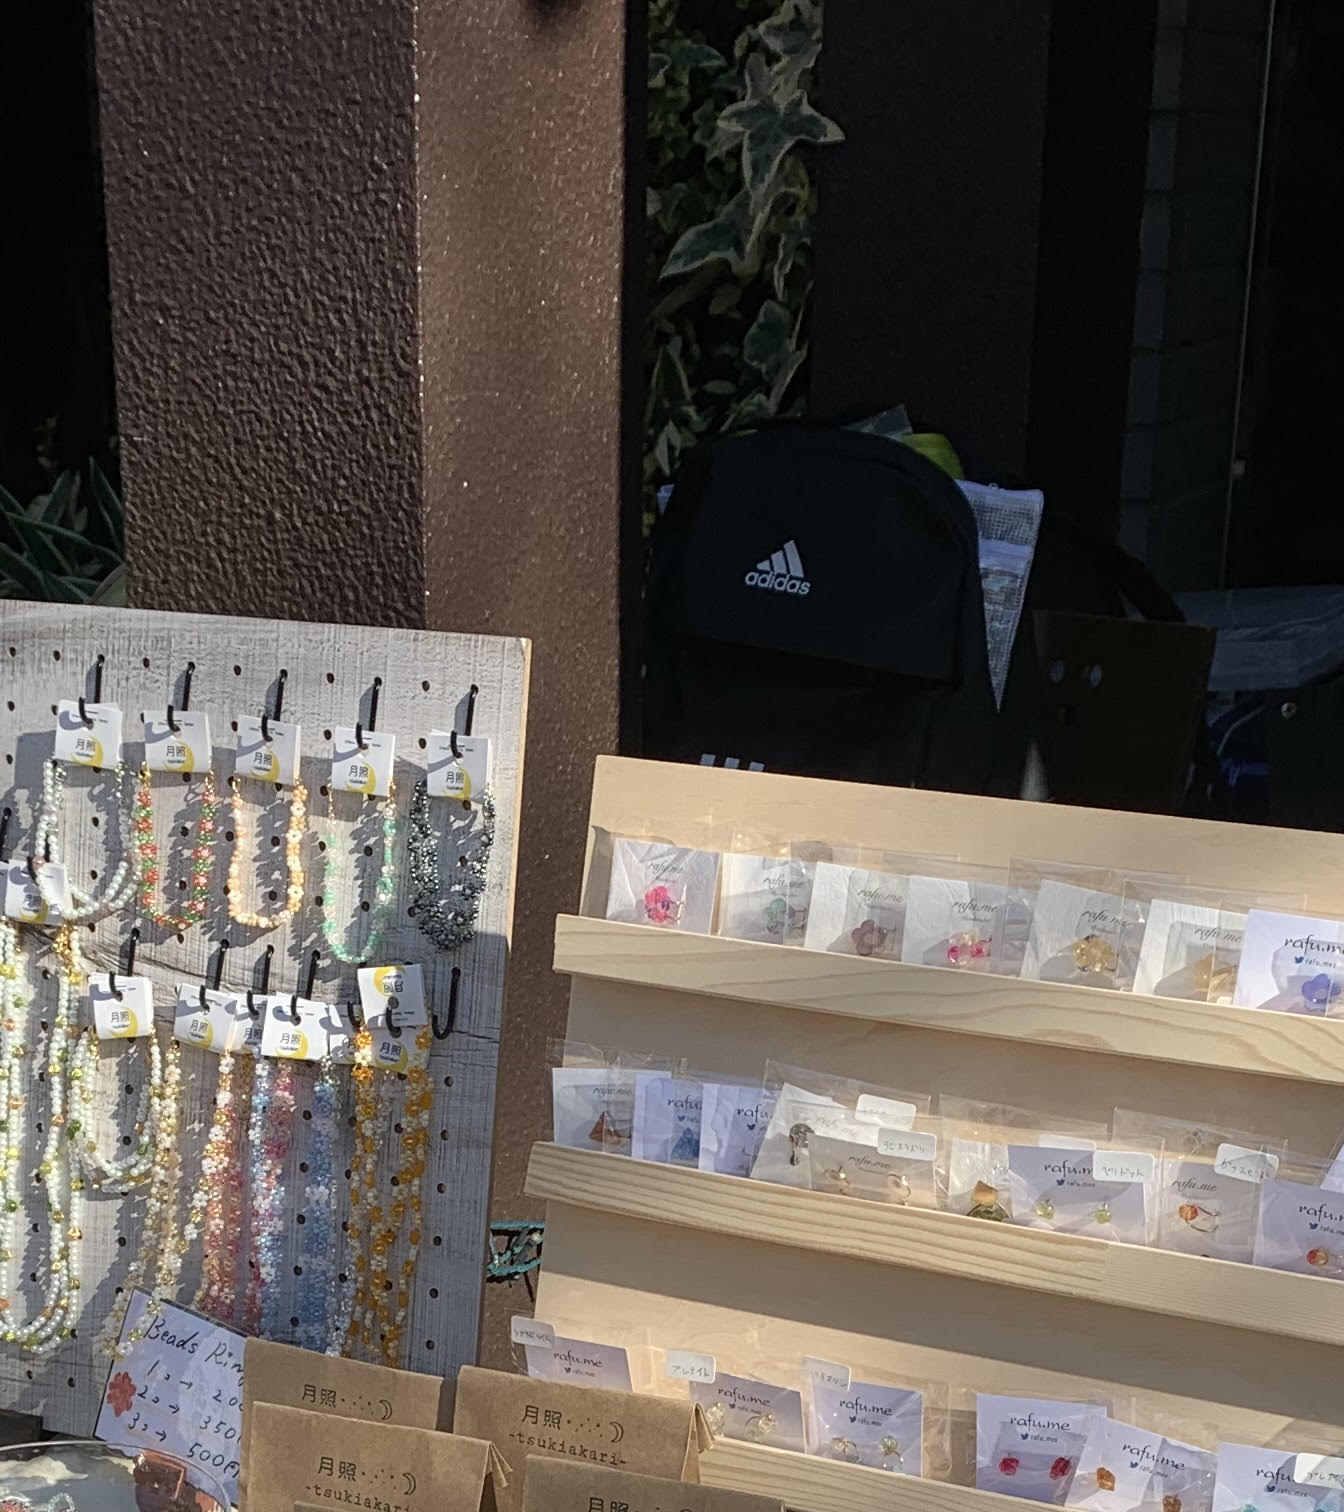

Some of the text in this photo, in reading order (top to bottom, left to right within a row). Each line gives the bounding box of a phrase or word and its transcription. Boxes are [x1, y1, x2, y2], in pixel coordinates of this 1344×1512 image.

[745, 569, 811, 596] adidas
[667, 1093, 703, 1112] rafu.
[737, 1105, 774, 1122] rafu.
[1044, 1158, 1094, 1179] rafu.m
[143, 1312, 200, 1355] Beads
[553, 1348, 605, 1370] rafu.me
[300, 1382, 338, 1408] 月照
[717, 1384, 771, 1409] rafu.me
[521, 1404, 563, 1431] 月照
[839, 1397, 894, 1418] rafu.me
[1009, 1412, 1072, 1432] rafu.me
[1122, 1441, 1186, 1472] rafu.me
[317, 1455, 358, 1482] 月照
[1256, 1465, 1296, 1485] rafu.
